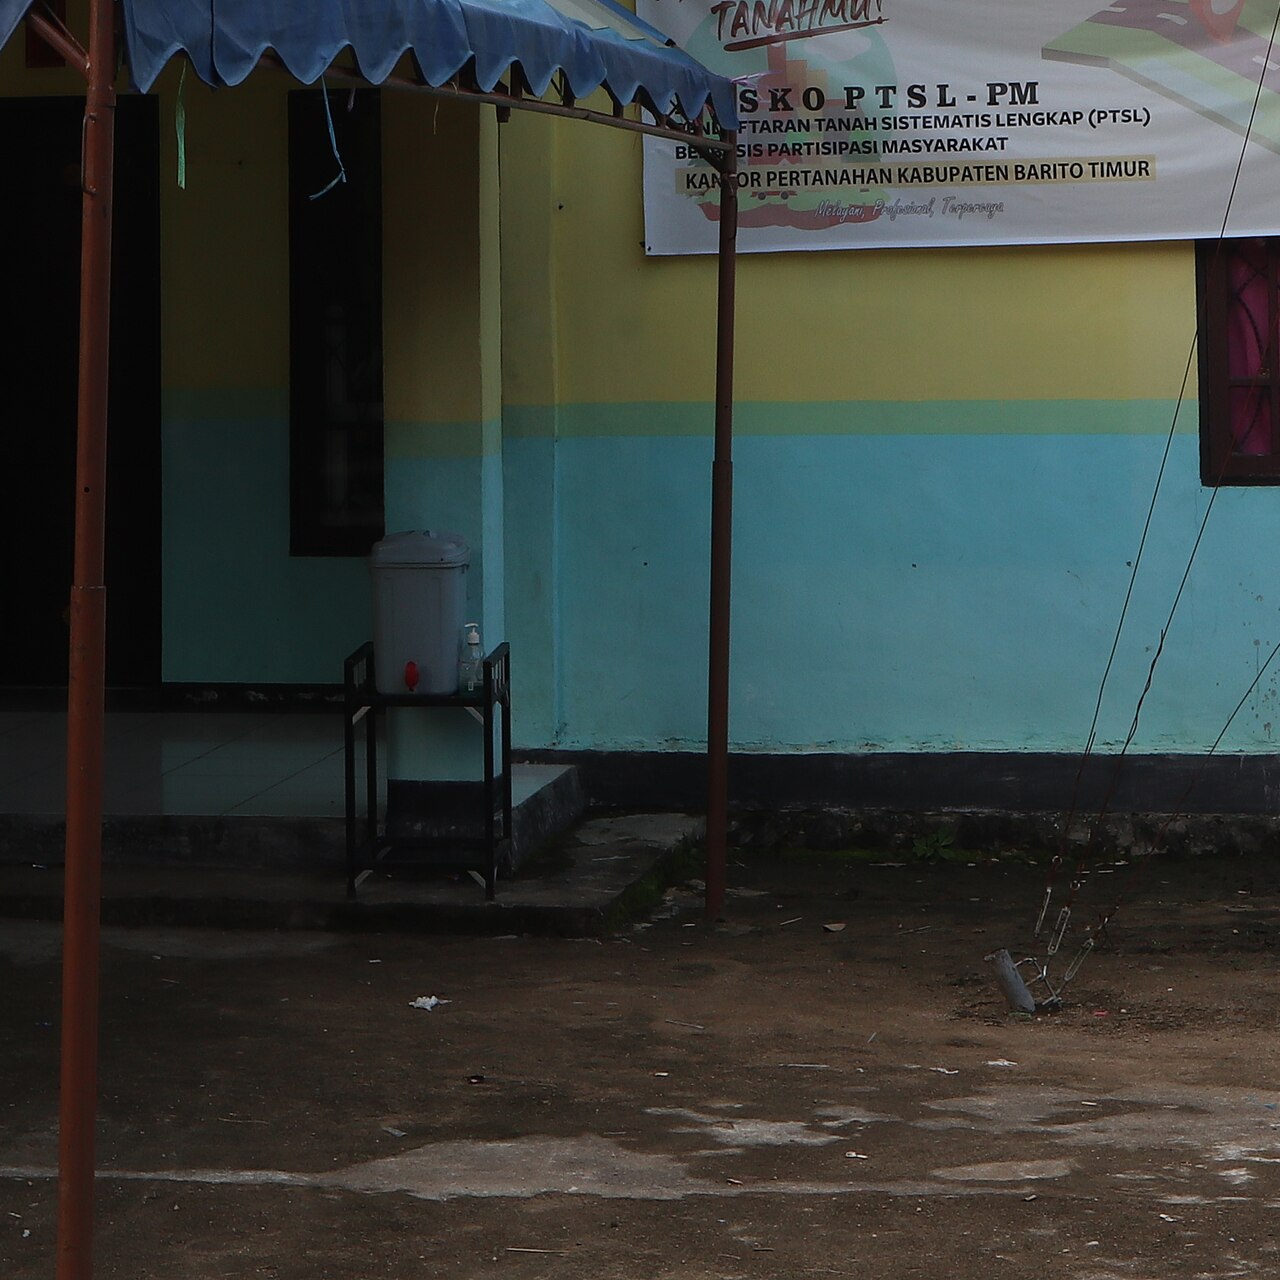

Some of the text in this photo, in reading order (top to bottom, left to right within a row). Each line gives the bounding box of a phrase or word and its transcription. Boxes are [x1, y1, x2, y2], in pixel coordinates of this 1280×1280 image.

[738, 86, 826, 114] SKO
[815, 115, 877, 132] TANAH
[882, 113, 992, 130] SISTEMATIS
[996, 111, 1084, 128] LENGKAP
[1087, 107, 1151, 129] (PTSL)
[675, 137, 1009, 160] BESIS PARTISIPASI MASYARAKAT
[686, 160, 1151, 189] KANOR PERTANAHAN KABUPATEN BARITO TIMUR
